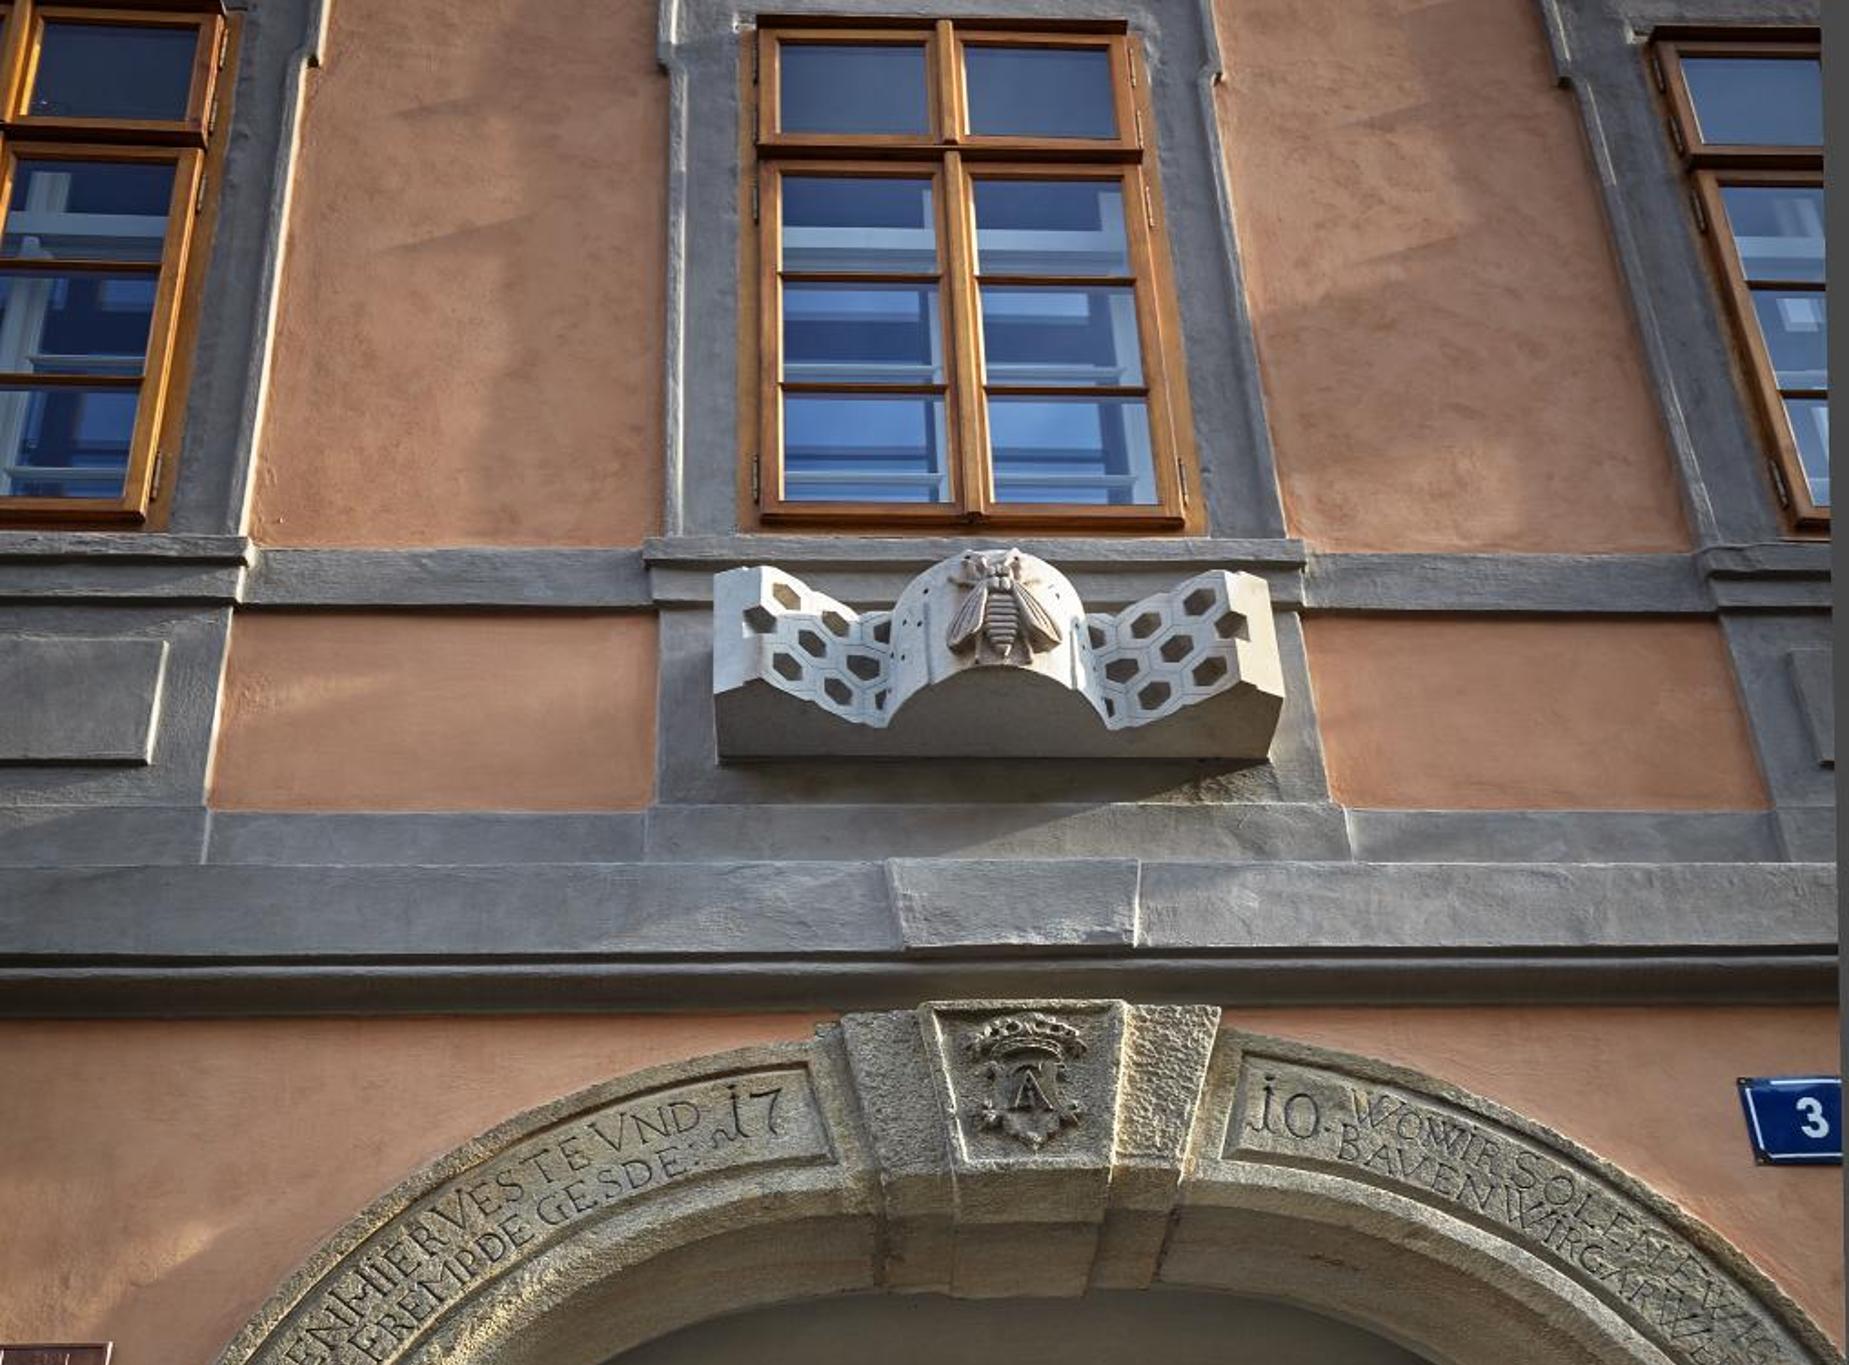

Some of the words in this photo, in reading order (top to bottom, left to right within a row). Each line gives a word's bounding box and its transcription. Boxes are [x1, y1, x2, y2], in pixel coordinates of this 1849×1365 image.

[587, 1100, 701, 1152] VND
[1796, 1096, 1830, 1138] 3
[1337, 1121, 1499, 1211] BAVEN
[1504, 1184, 1583, 1259] WIR
